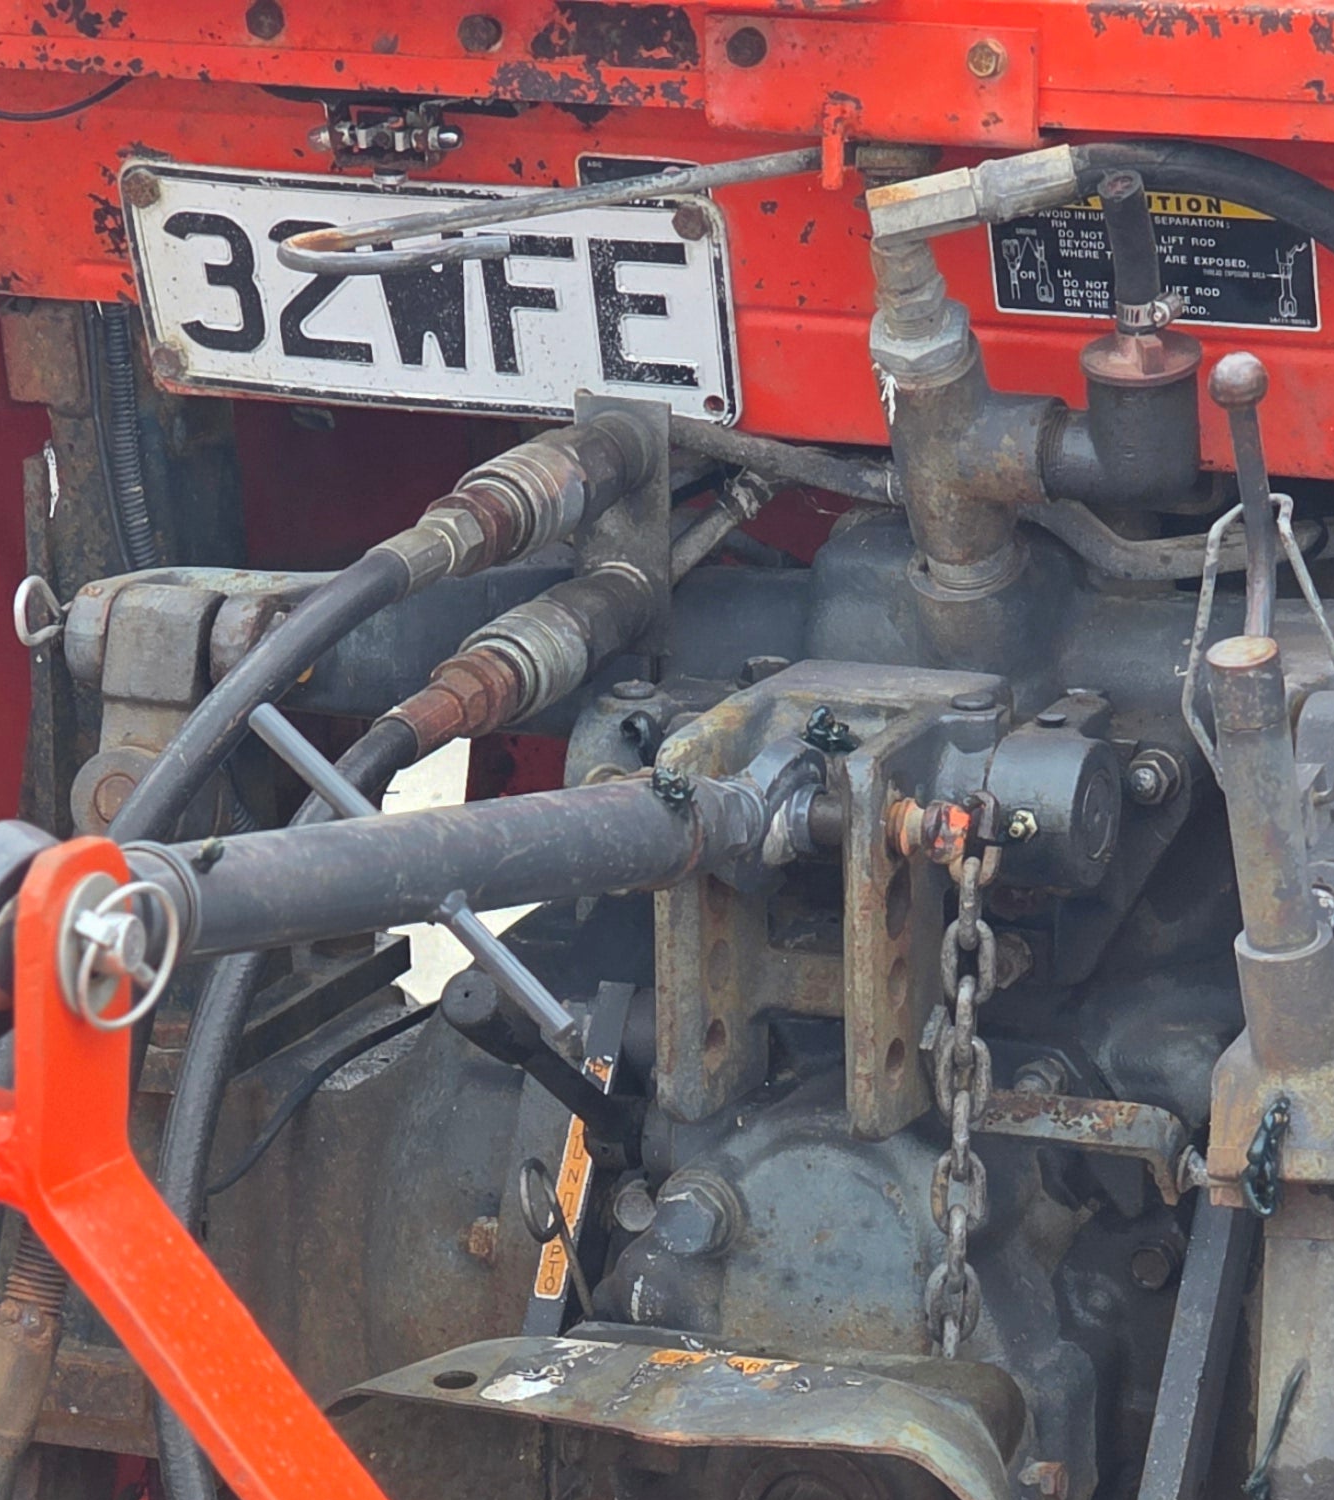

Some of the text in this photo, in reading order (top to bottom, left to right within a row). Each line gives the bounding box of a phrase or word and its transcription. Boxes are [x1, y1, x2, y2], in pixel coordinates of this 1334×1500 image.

[1038, 209, 1072, 219] AVOID
[1051, 219, 1067, 228] RH
[1058, 229, 1216, 248] DO NOT LIFT ROD
[1059, 239, 1106, 249] BEYOND
[1059, 248, 1100, 259] WHERE
[1164, 254, 1188, 265] ARE
[1019, 270, 1037, 280] OR
[1057, 269, 1072, 278] LH
[1062, 279, 1079, 288] DO
[1085, 280, 1109, 290] NOT
[1195, 286, 1221, 297] ROD
[1063, 289, 1110, 299] BEYOND
[1064, 298, 1082, 307] ON
[1087, 298, 1109, 309] THE
[566, 1168, 580, 1184] N
[543, 1244, 564, 1292] PTO
